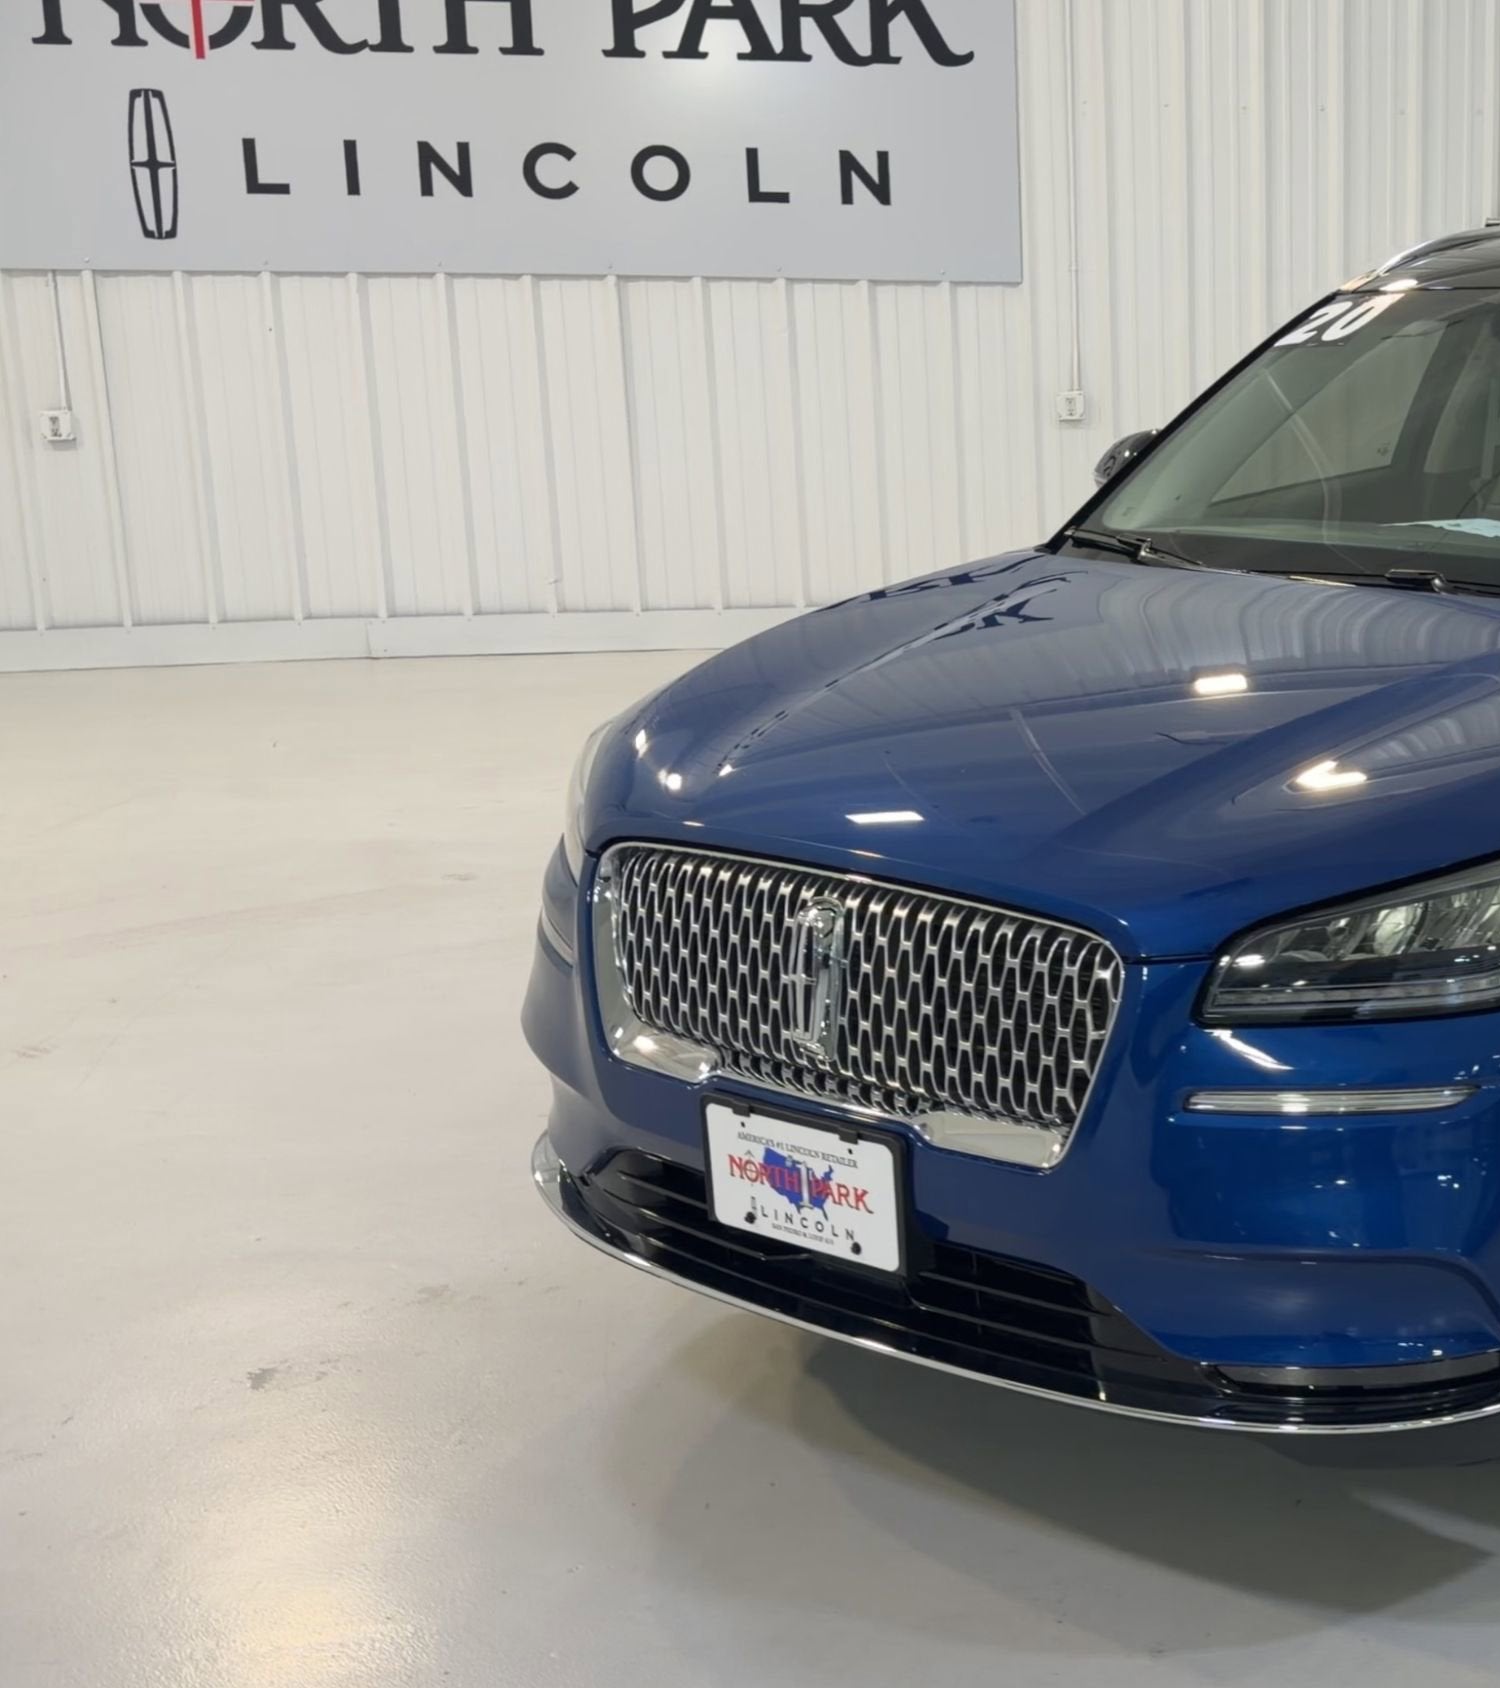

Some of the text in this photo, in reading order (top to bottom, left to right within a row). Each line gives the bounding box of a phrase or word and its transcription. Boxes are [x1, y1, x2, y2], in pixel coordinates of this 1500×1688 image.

[241, 137, 893, 207] LINCOLN
[1273, 293, 1405, 347] 20
[727, 1153, 875, 1215] NORTH PARK
[761, 1205, 855, 1240] LINCOLN
